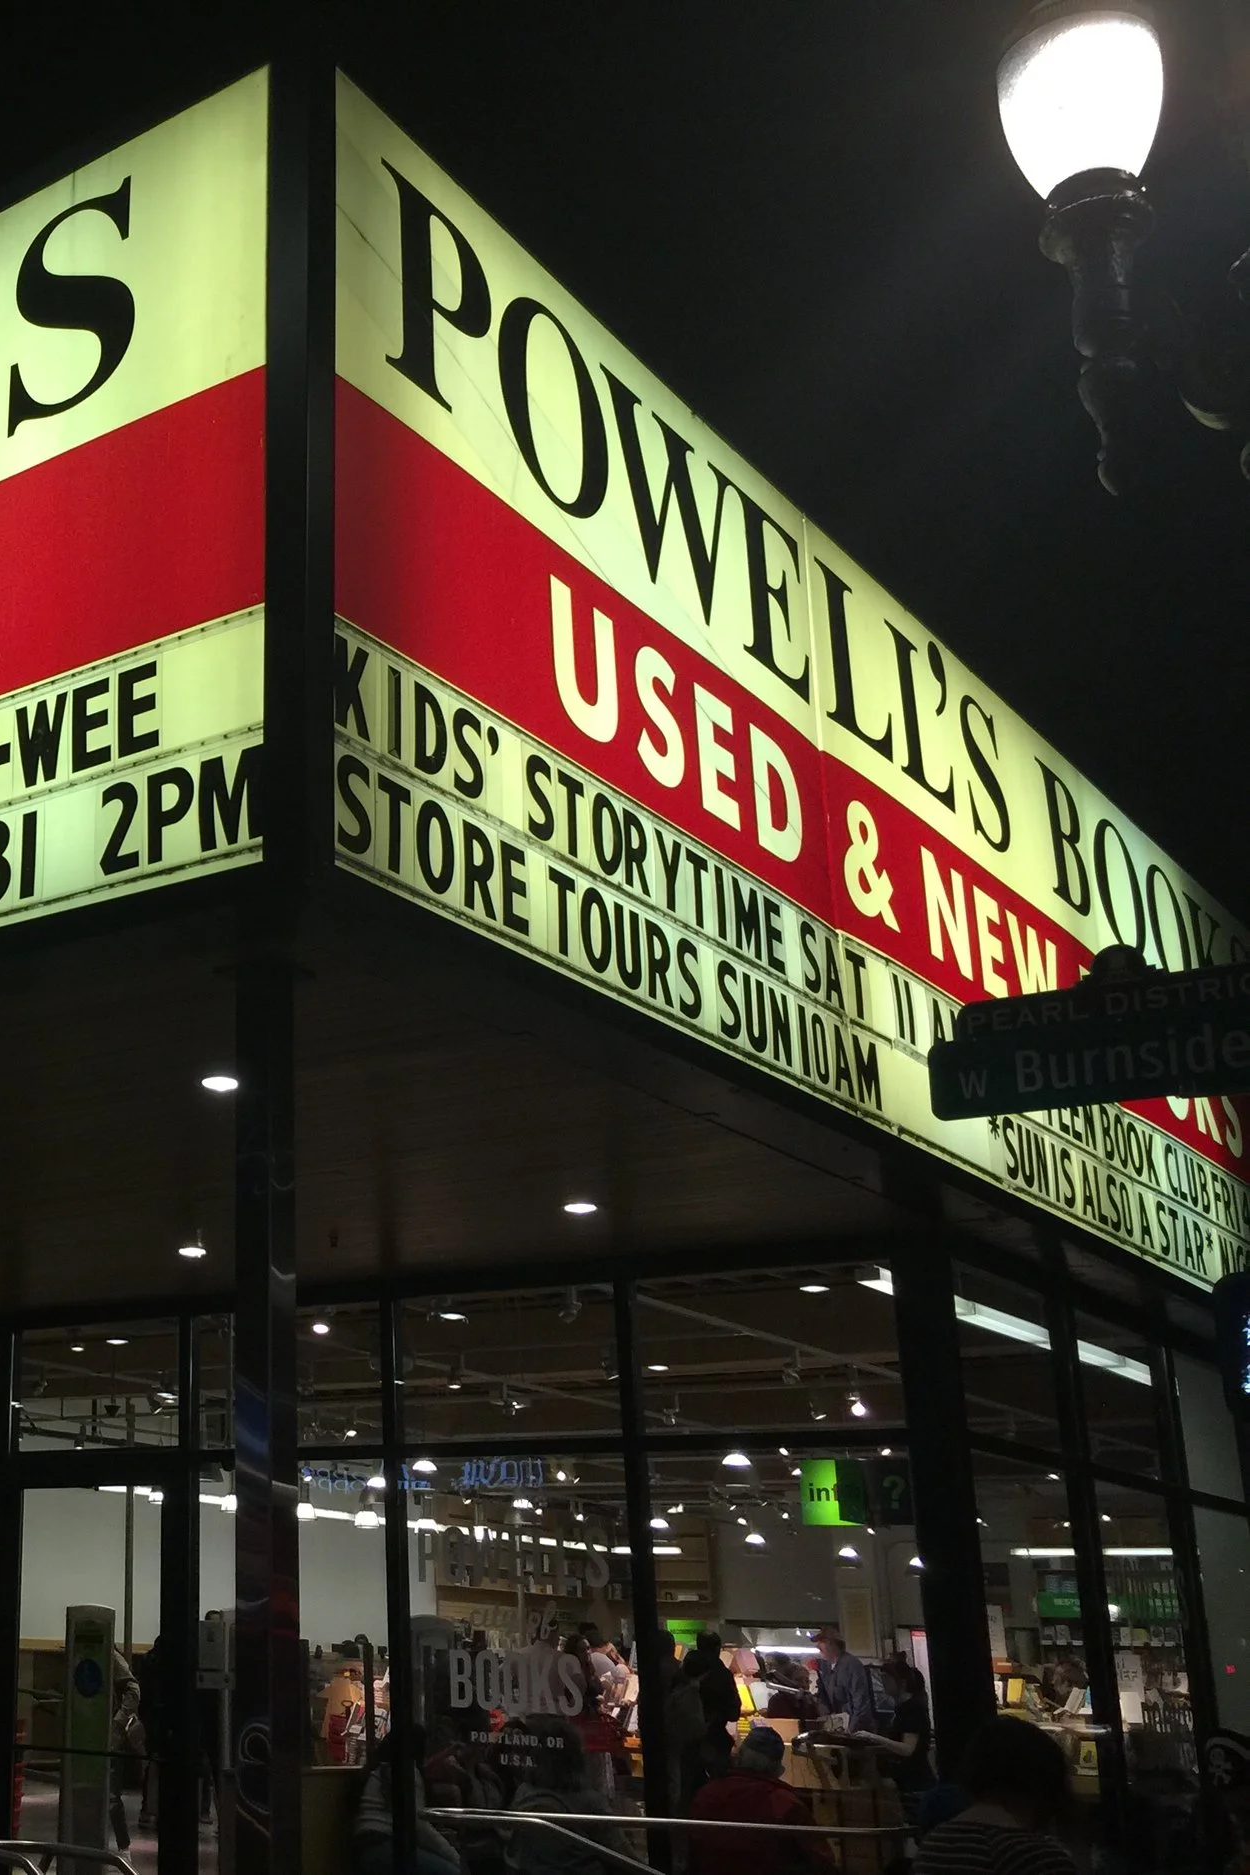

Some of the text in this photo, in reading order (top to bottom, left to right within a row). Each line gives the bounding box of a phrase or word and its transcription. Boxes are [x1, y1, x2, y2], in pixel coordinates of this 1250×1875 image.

[381, 157, 1010, 852] POWELL'S
[99, 744, 264, 876] 2PM
[335, 635, 501, 799] KIDS'
[526, 754, 787, 975] STORYTIME
[800, 921, 867, 1020] SAT
[550, 573, 1057, 998] USED & NEW
[337, 755, 530, 936] STORE
[548, 867, 703, 1020] TOURS
[717, 959, 793, 1067] SUN
[958, 1021, 1250, 1100] W Burnside
[967, 998, 1090, 1035] PEARL
[1080, 1158, 1135, 1239] ALSO
[1101, 1101, 1161, 1188] BOOK
[1163, 1142, 1211, 1216] CLUB
[450, 1649, 584, 1717] BOOKS
